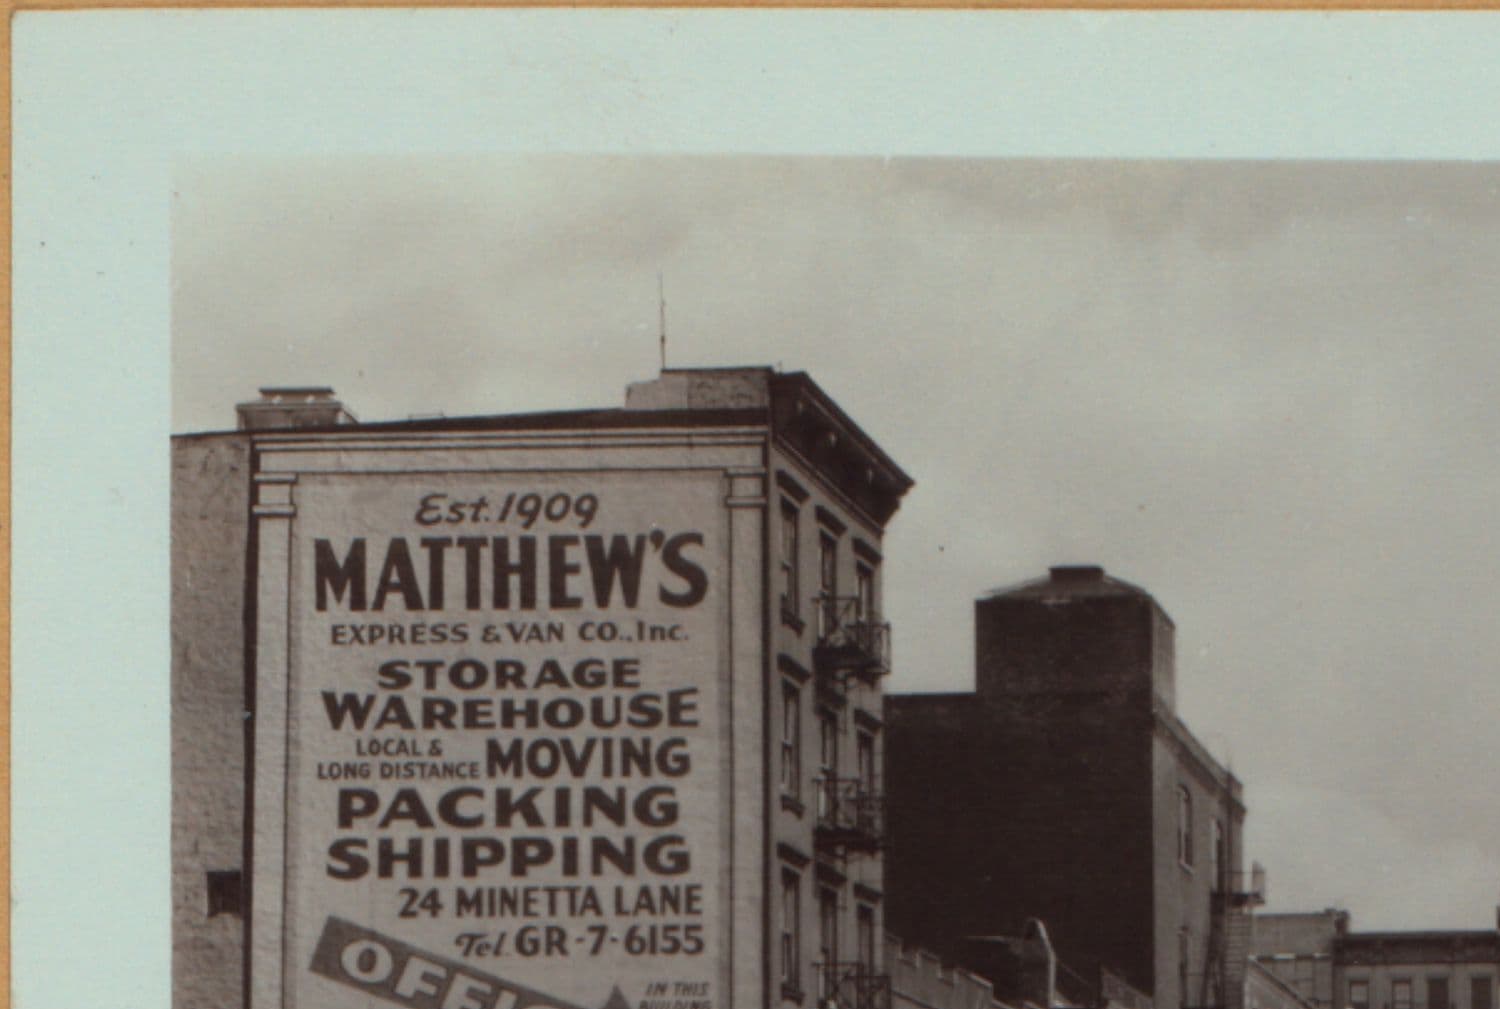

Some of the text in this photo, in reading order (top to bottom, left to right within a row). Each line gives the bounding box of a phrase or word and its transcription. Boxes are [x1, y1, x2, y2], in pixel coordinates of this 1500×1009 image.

[415, 492, 599, 529] Est. 1909
[313, 529, 709, 611] MATTHEW'S
[331, 623, 469, 646] EXPRESS
[482, 624, 502, 643] &
[505, 622, 565, 643] VAN
[637, 620, 689, 642] Inc.
[377, 658, 641, 691] STORAGE
[321, 688, 700, 731] WAREHOUSE
[356, 739, 443, 757] LOCAL &
[486, 737, 691, 780] MOVING
[317, 762, 480, 780] LONG DISTANCE
[338, 787, 680, 829] PACKING
[326, 835, 691, 881] SHIPPING
[397, 884, 703, 918] 24 MINETTA LANE
